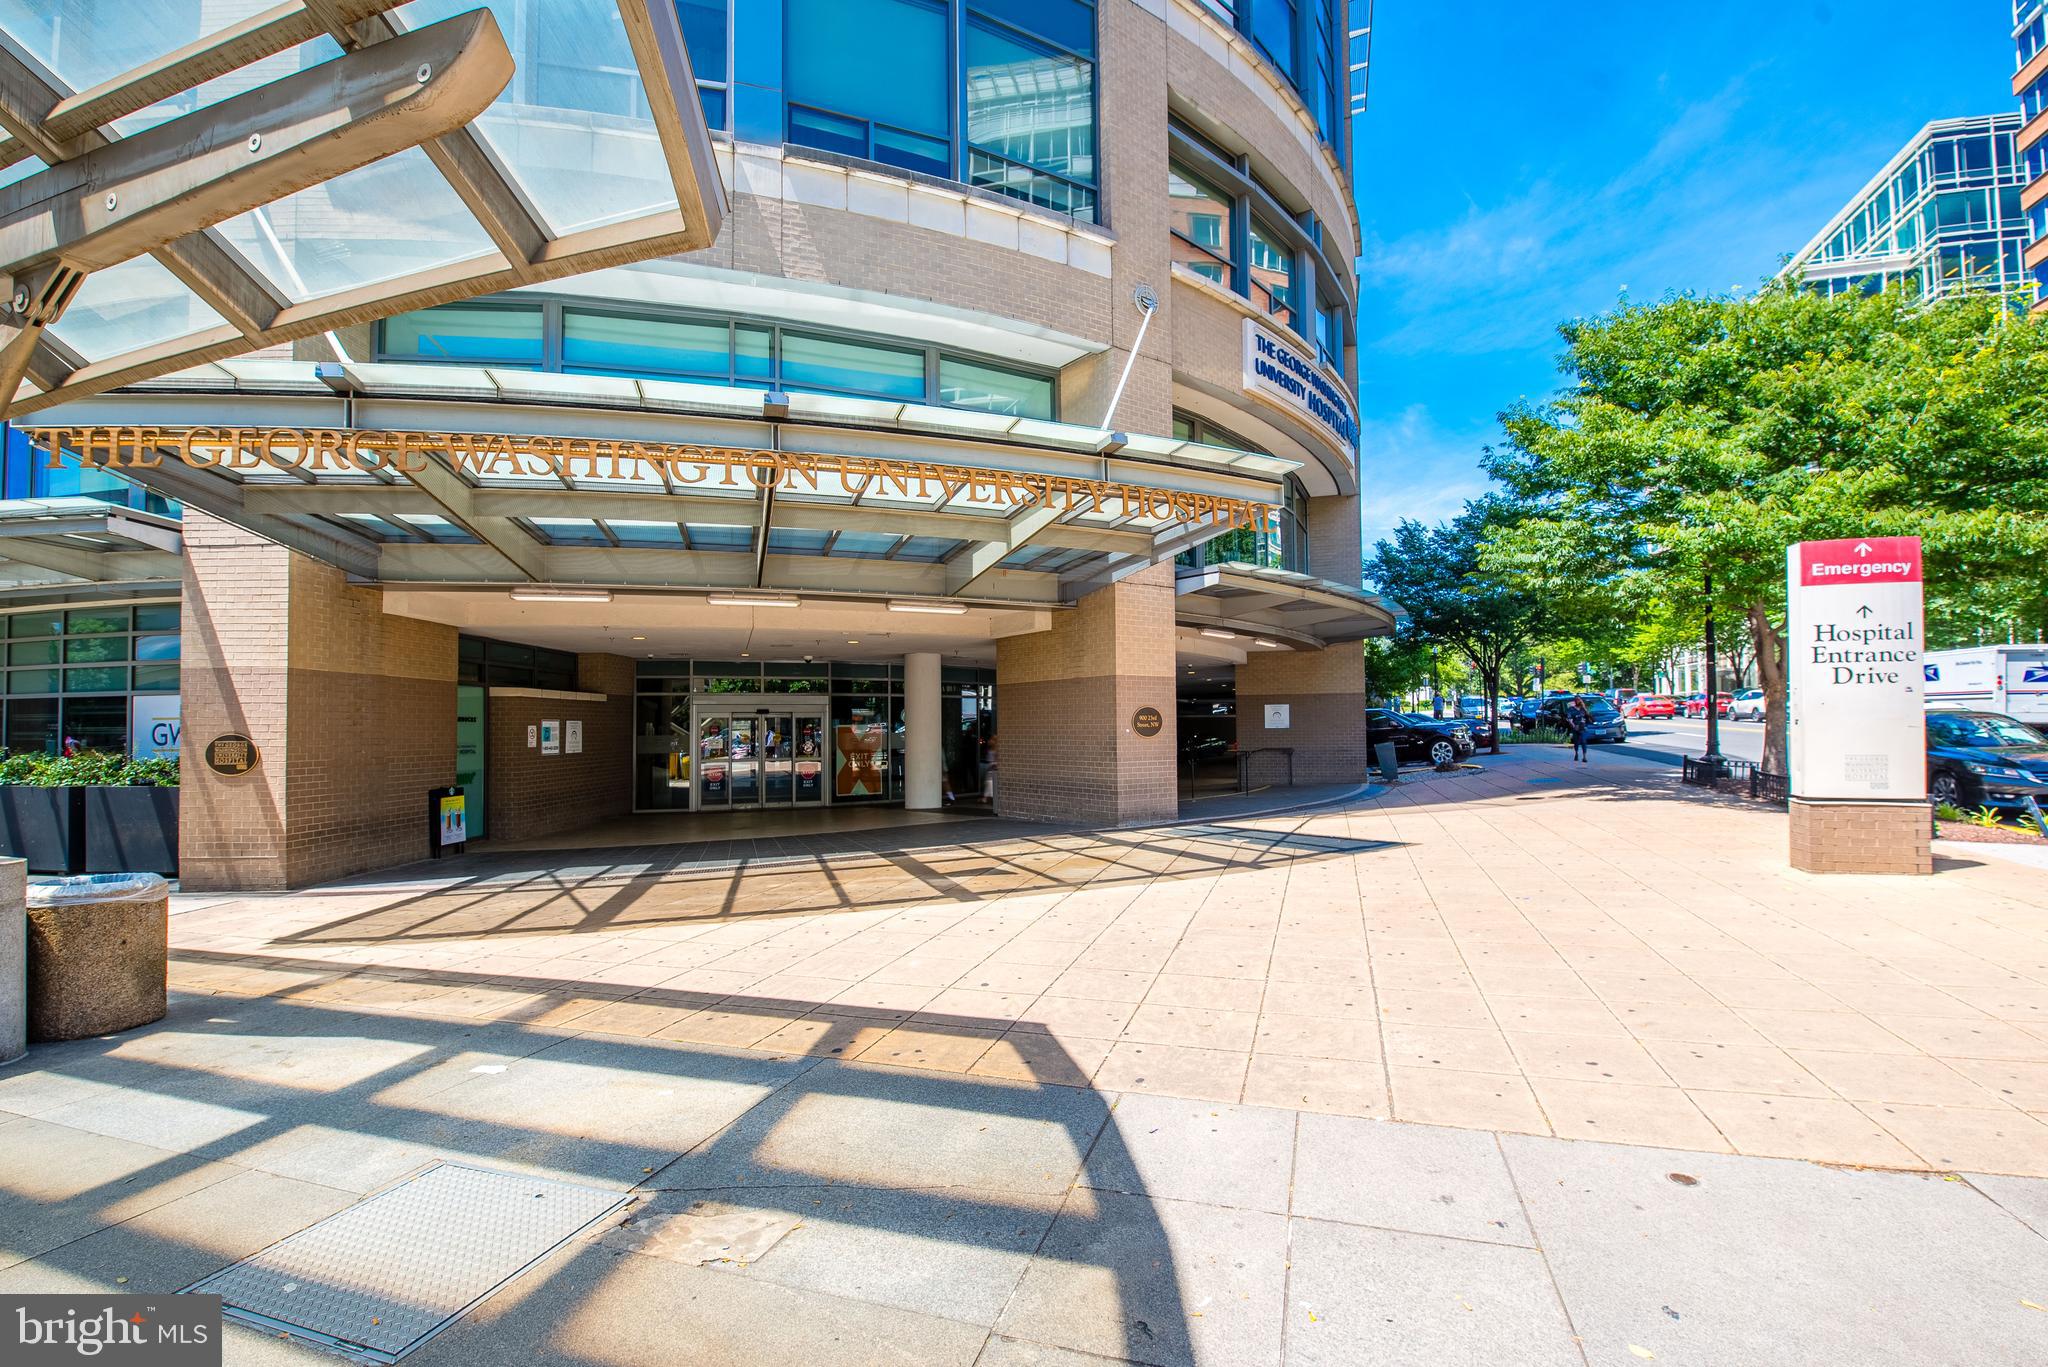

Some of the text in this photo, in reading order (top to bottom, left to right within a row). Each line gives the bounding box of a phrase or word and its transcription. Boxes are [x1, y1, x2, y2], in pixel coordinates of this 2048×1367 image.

[1255, 334, 1276, 359] THE
[1277, 349, 1311, 382] GEORGE
[1255, 358, 1306, 400] UNIVERSITY
[33, 427, 1280, 533] THE GEORGE WASHINGTON UNIVERSITY HOSPITAL
[1811, 562, 1912, 577] Emergency
[1813, 622, 1914, 645] Hospital
[1811, 646, 1917, 664] Entrance
[1832, 667, 1899, 685] Drive
[850, 752, 869, 760] EXIT
